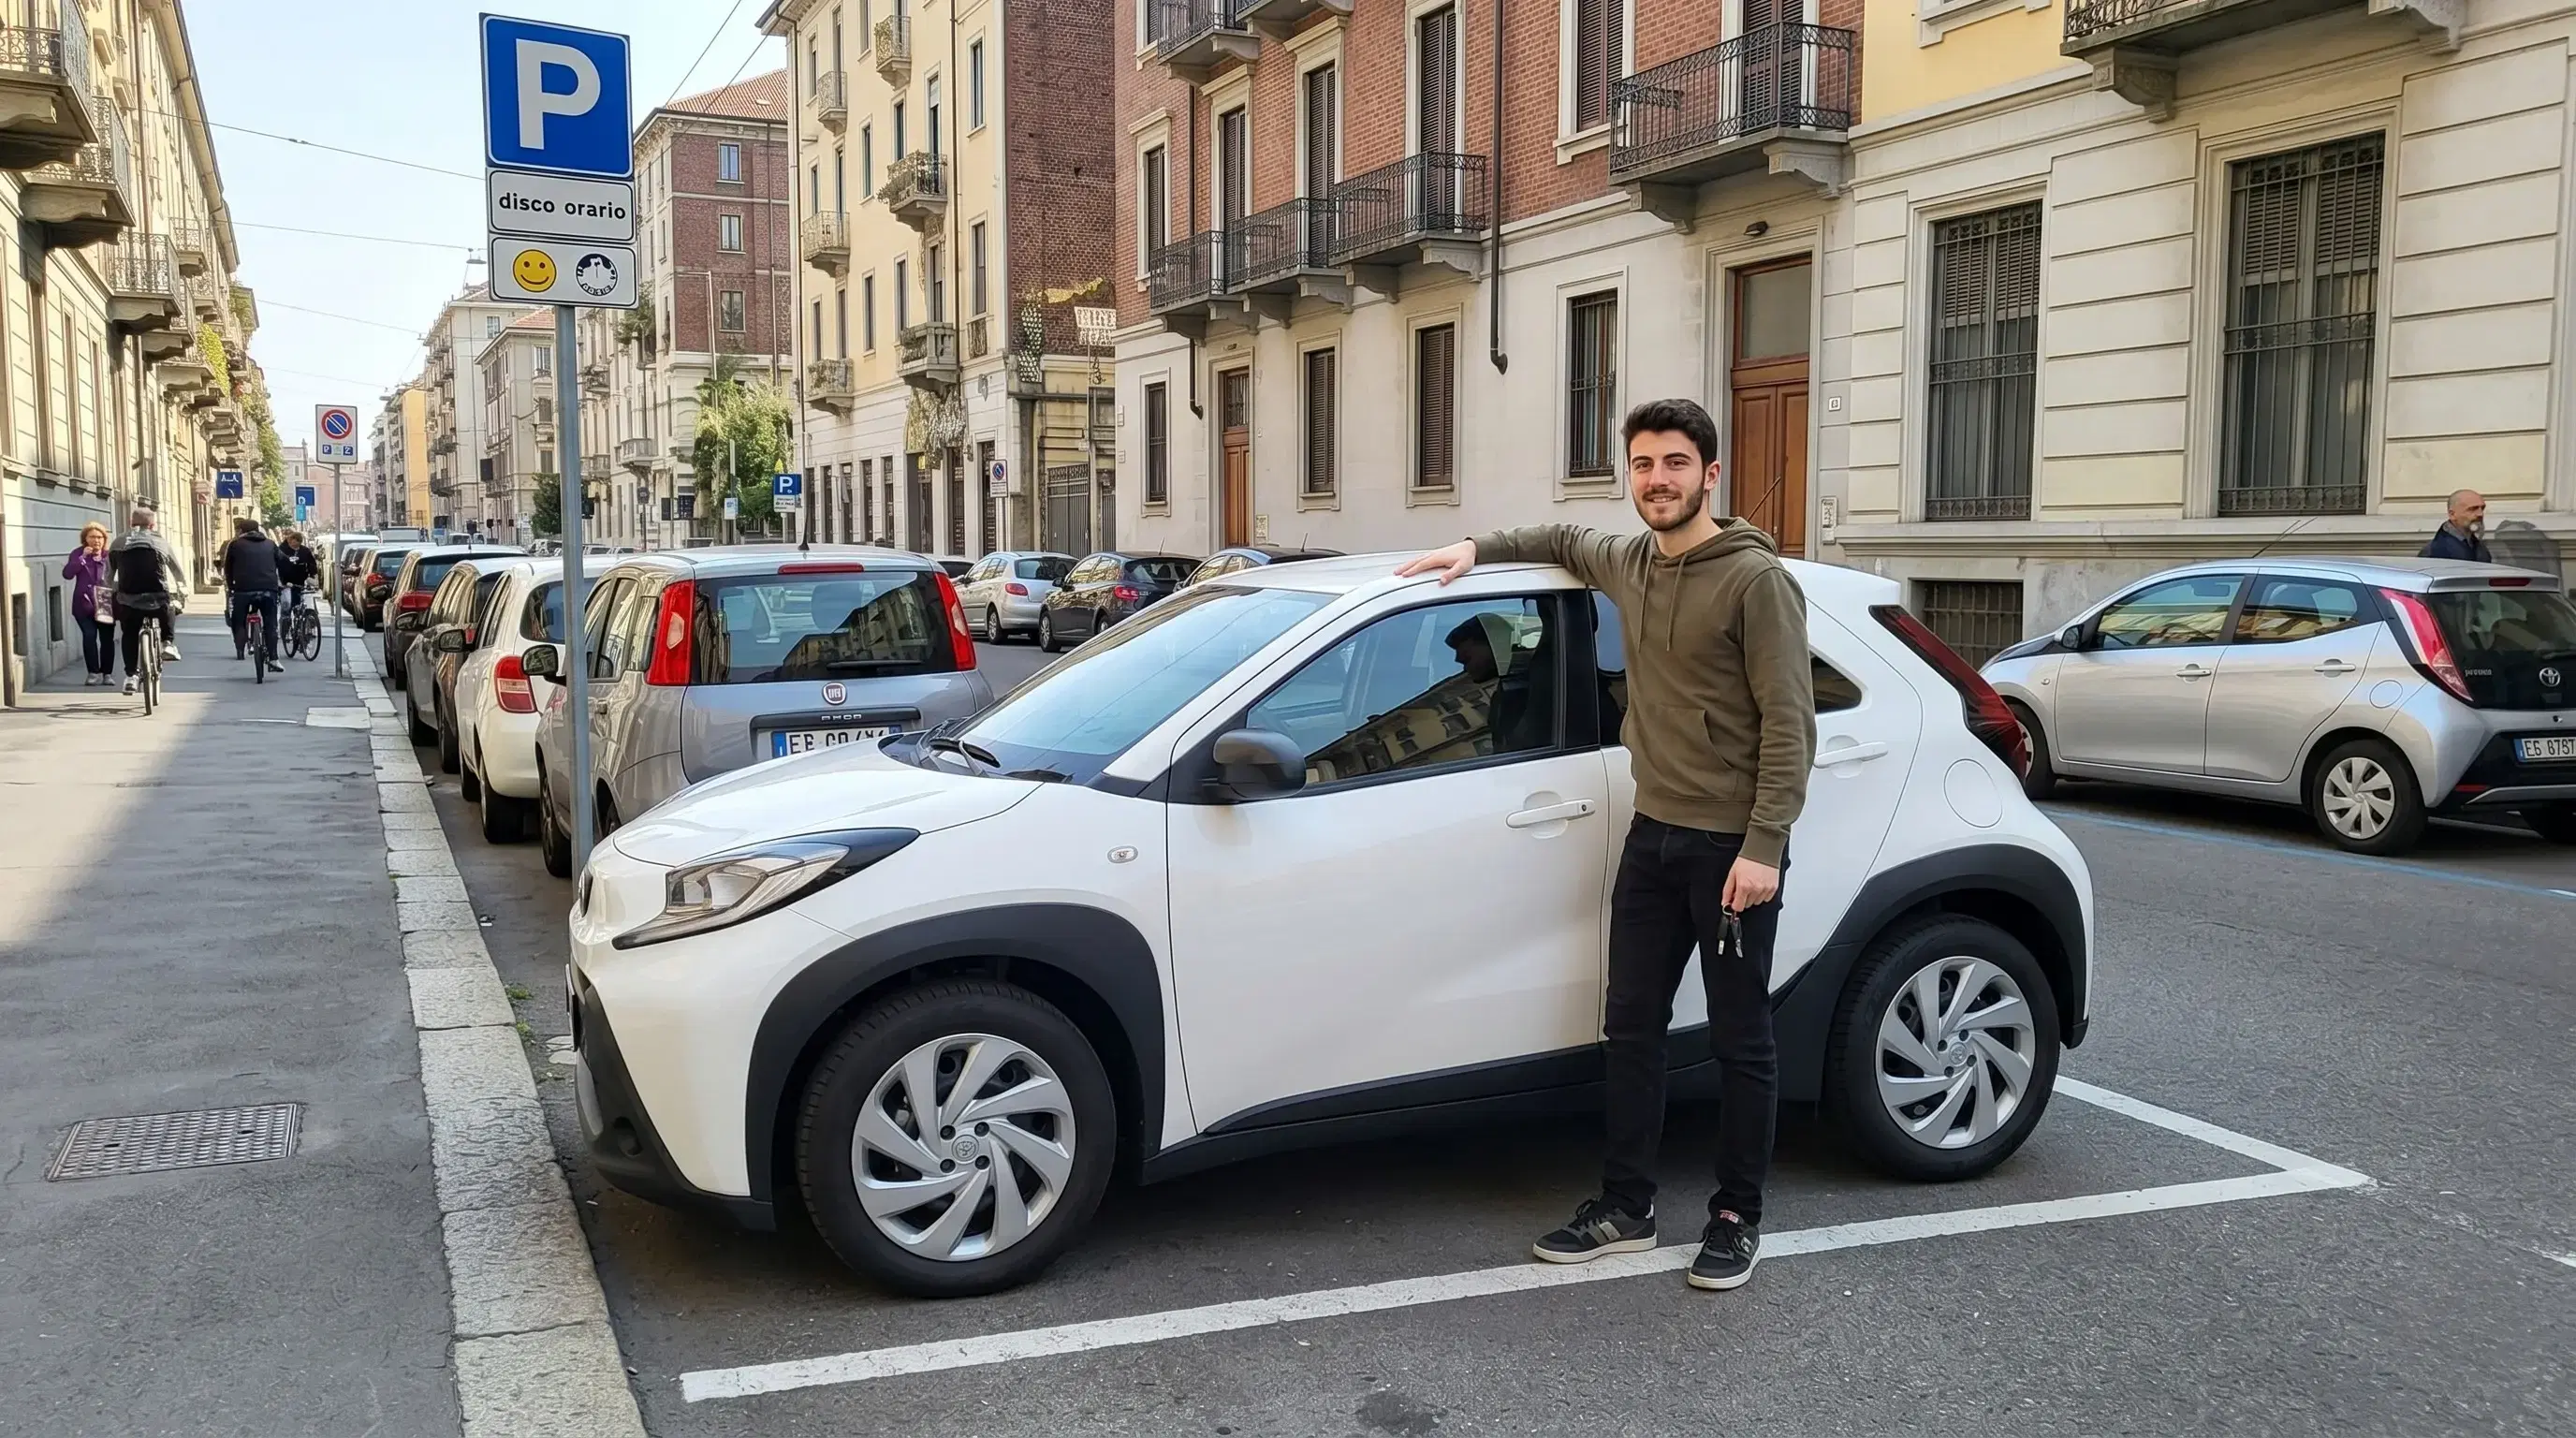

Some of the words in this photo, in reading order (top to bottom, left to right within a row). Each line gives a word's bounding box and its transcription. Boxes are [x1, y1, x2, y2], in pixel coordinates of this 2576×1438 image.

[516, 38, 601, 150] P
[499, 192, 555, 213] disco
[564, 201, 626, 219] orario
[779, 476, 794, 493] P
